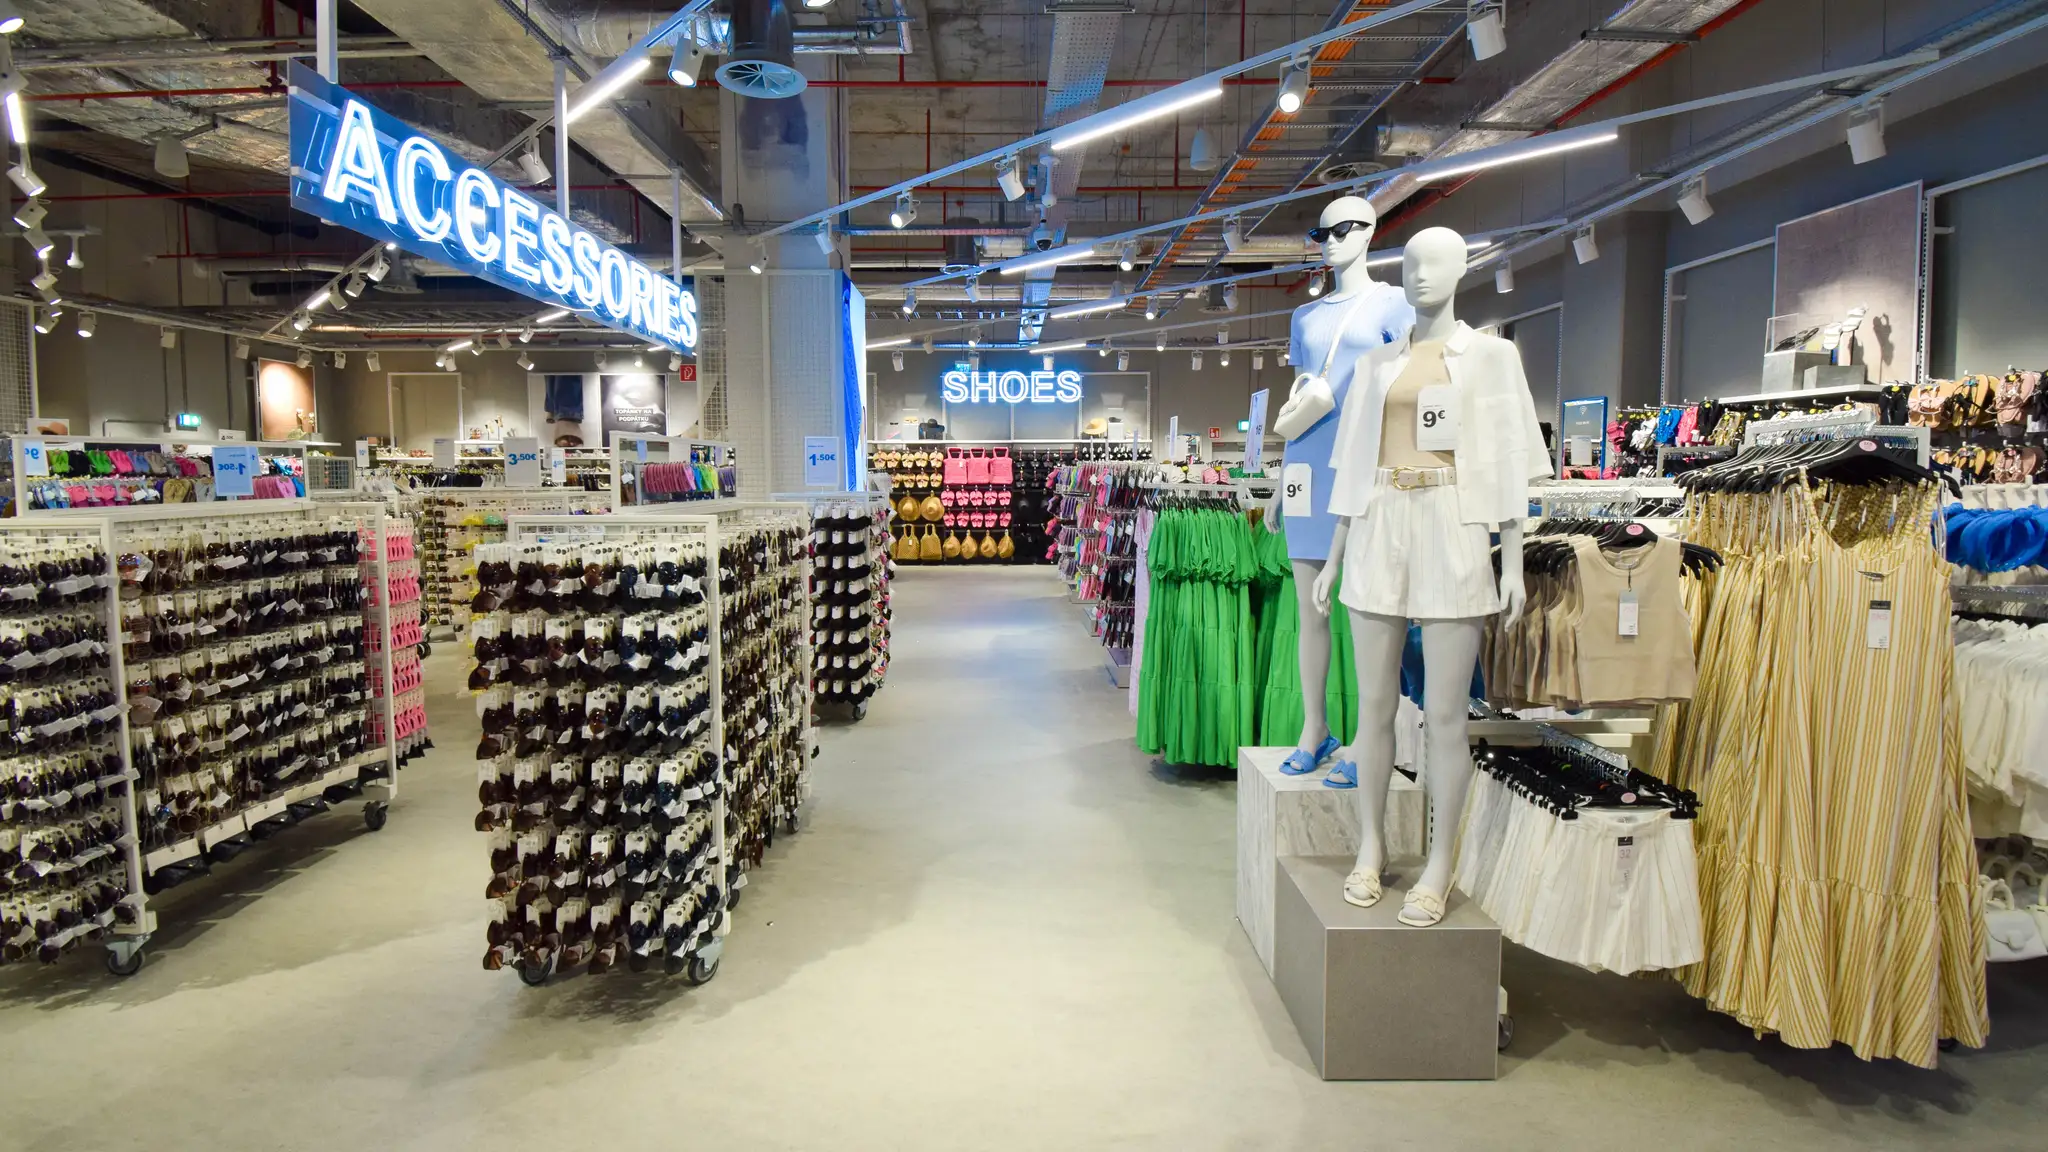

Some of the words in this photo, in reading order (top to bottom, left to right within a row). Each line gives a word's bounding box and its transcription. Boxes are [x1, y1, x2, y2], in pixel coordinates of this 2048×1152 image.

[323, 98, 698, 348] ACCESSORIES
[943, 370, 1082, 404] SHOES
[1422, 409, 1446, 428] 9€
[508, 453, 537, 466] 3.50€
[808, 453, 836, 466] 1.50€
